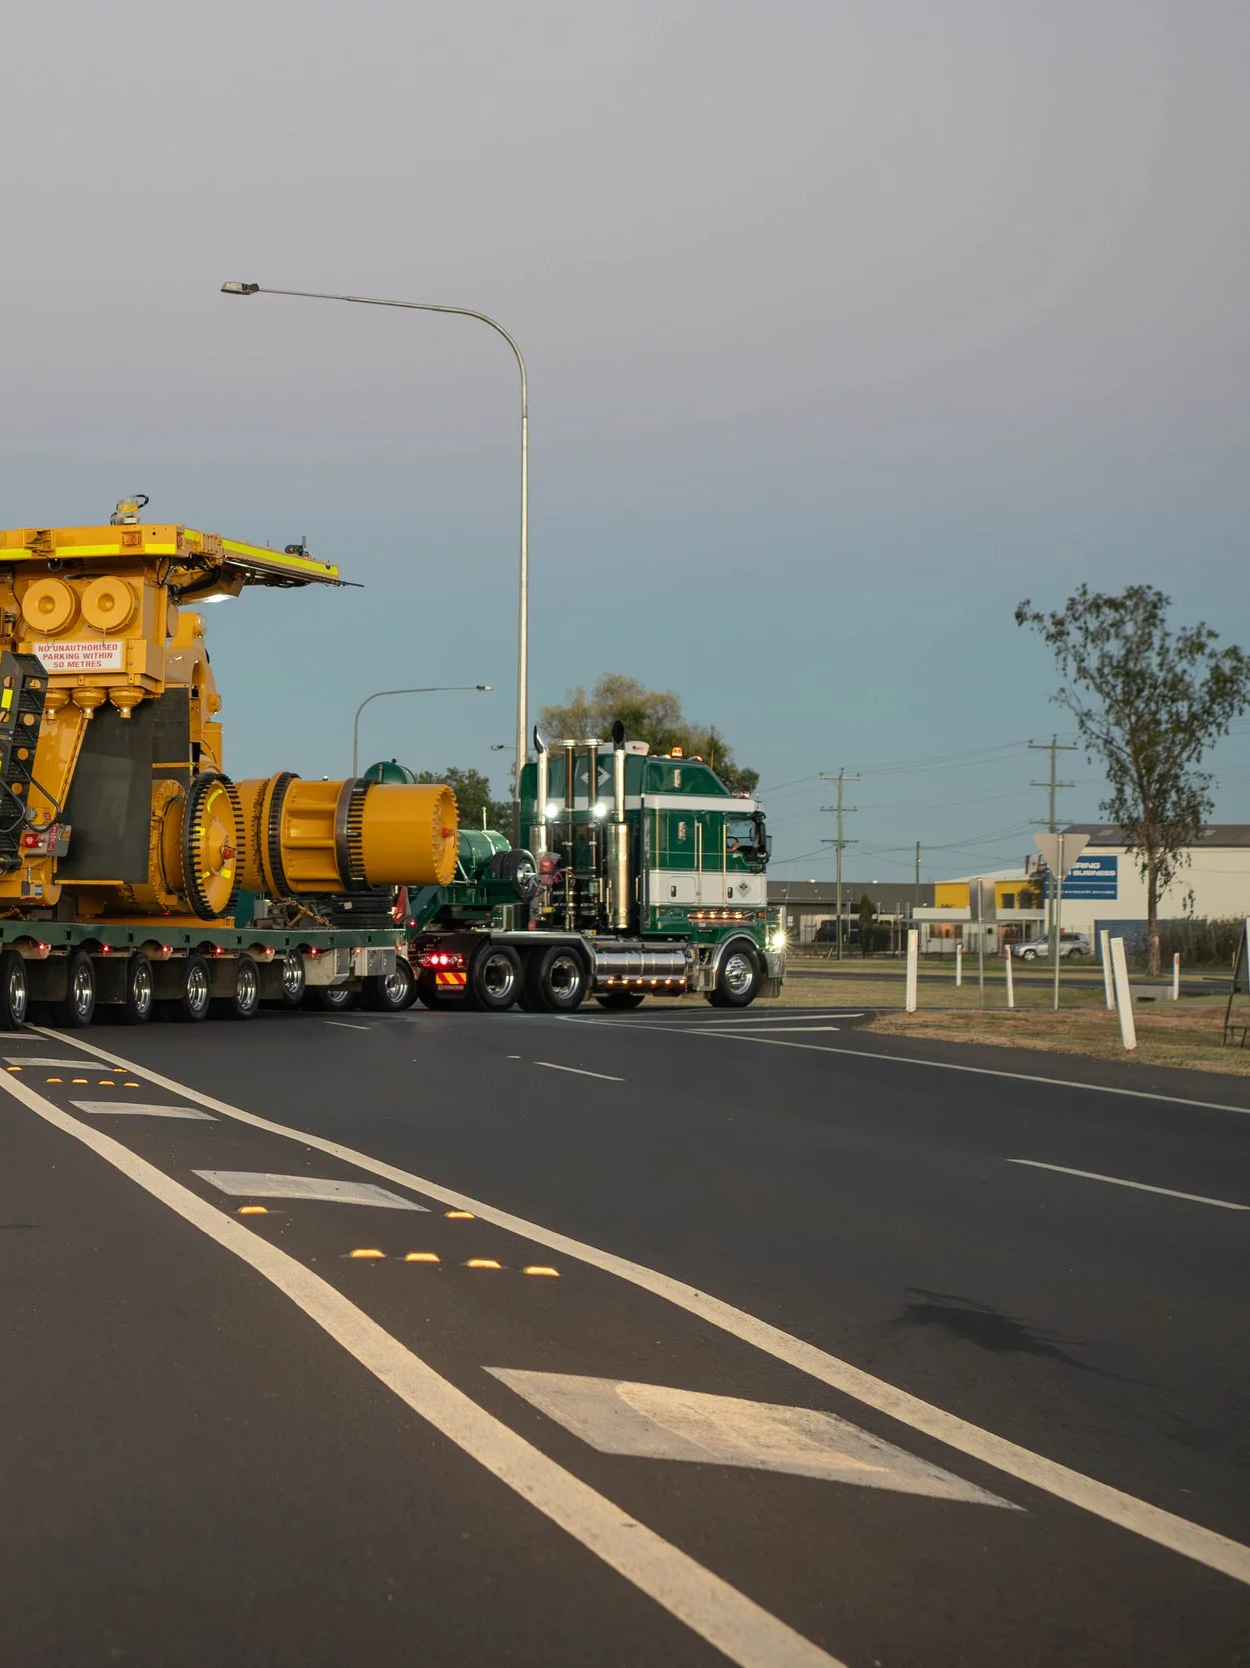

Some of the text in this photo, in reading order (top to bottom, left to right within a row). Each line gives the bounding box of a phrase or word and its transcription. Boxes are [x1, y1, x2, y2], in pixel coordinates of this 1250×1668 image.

[38, 643, 118, 653] NO UNAUTHORISED
[42, 653, 80, 661] PARKING
[67, 660, 102, 668] METRES
